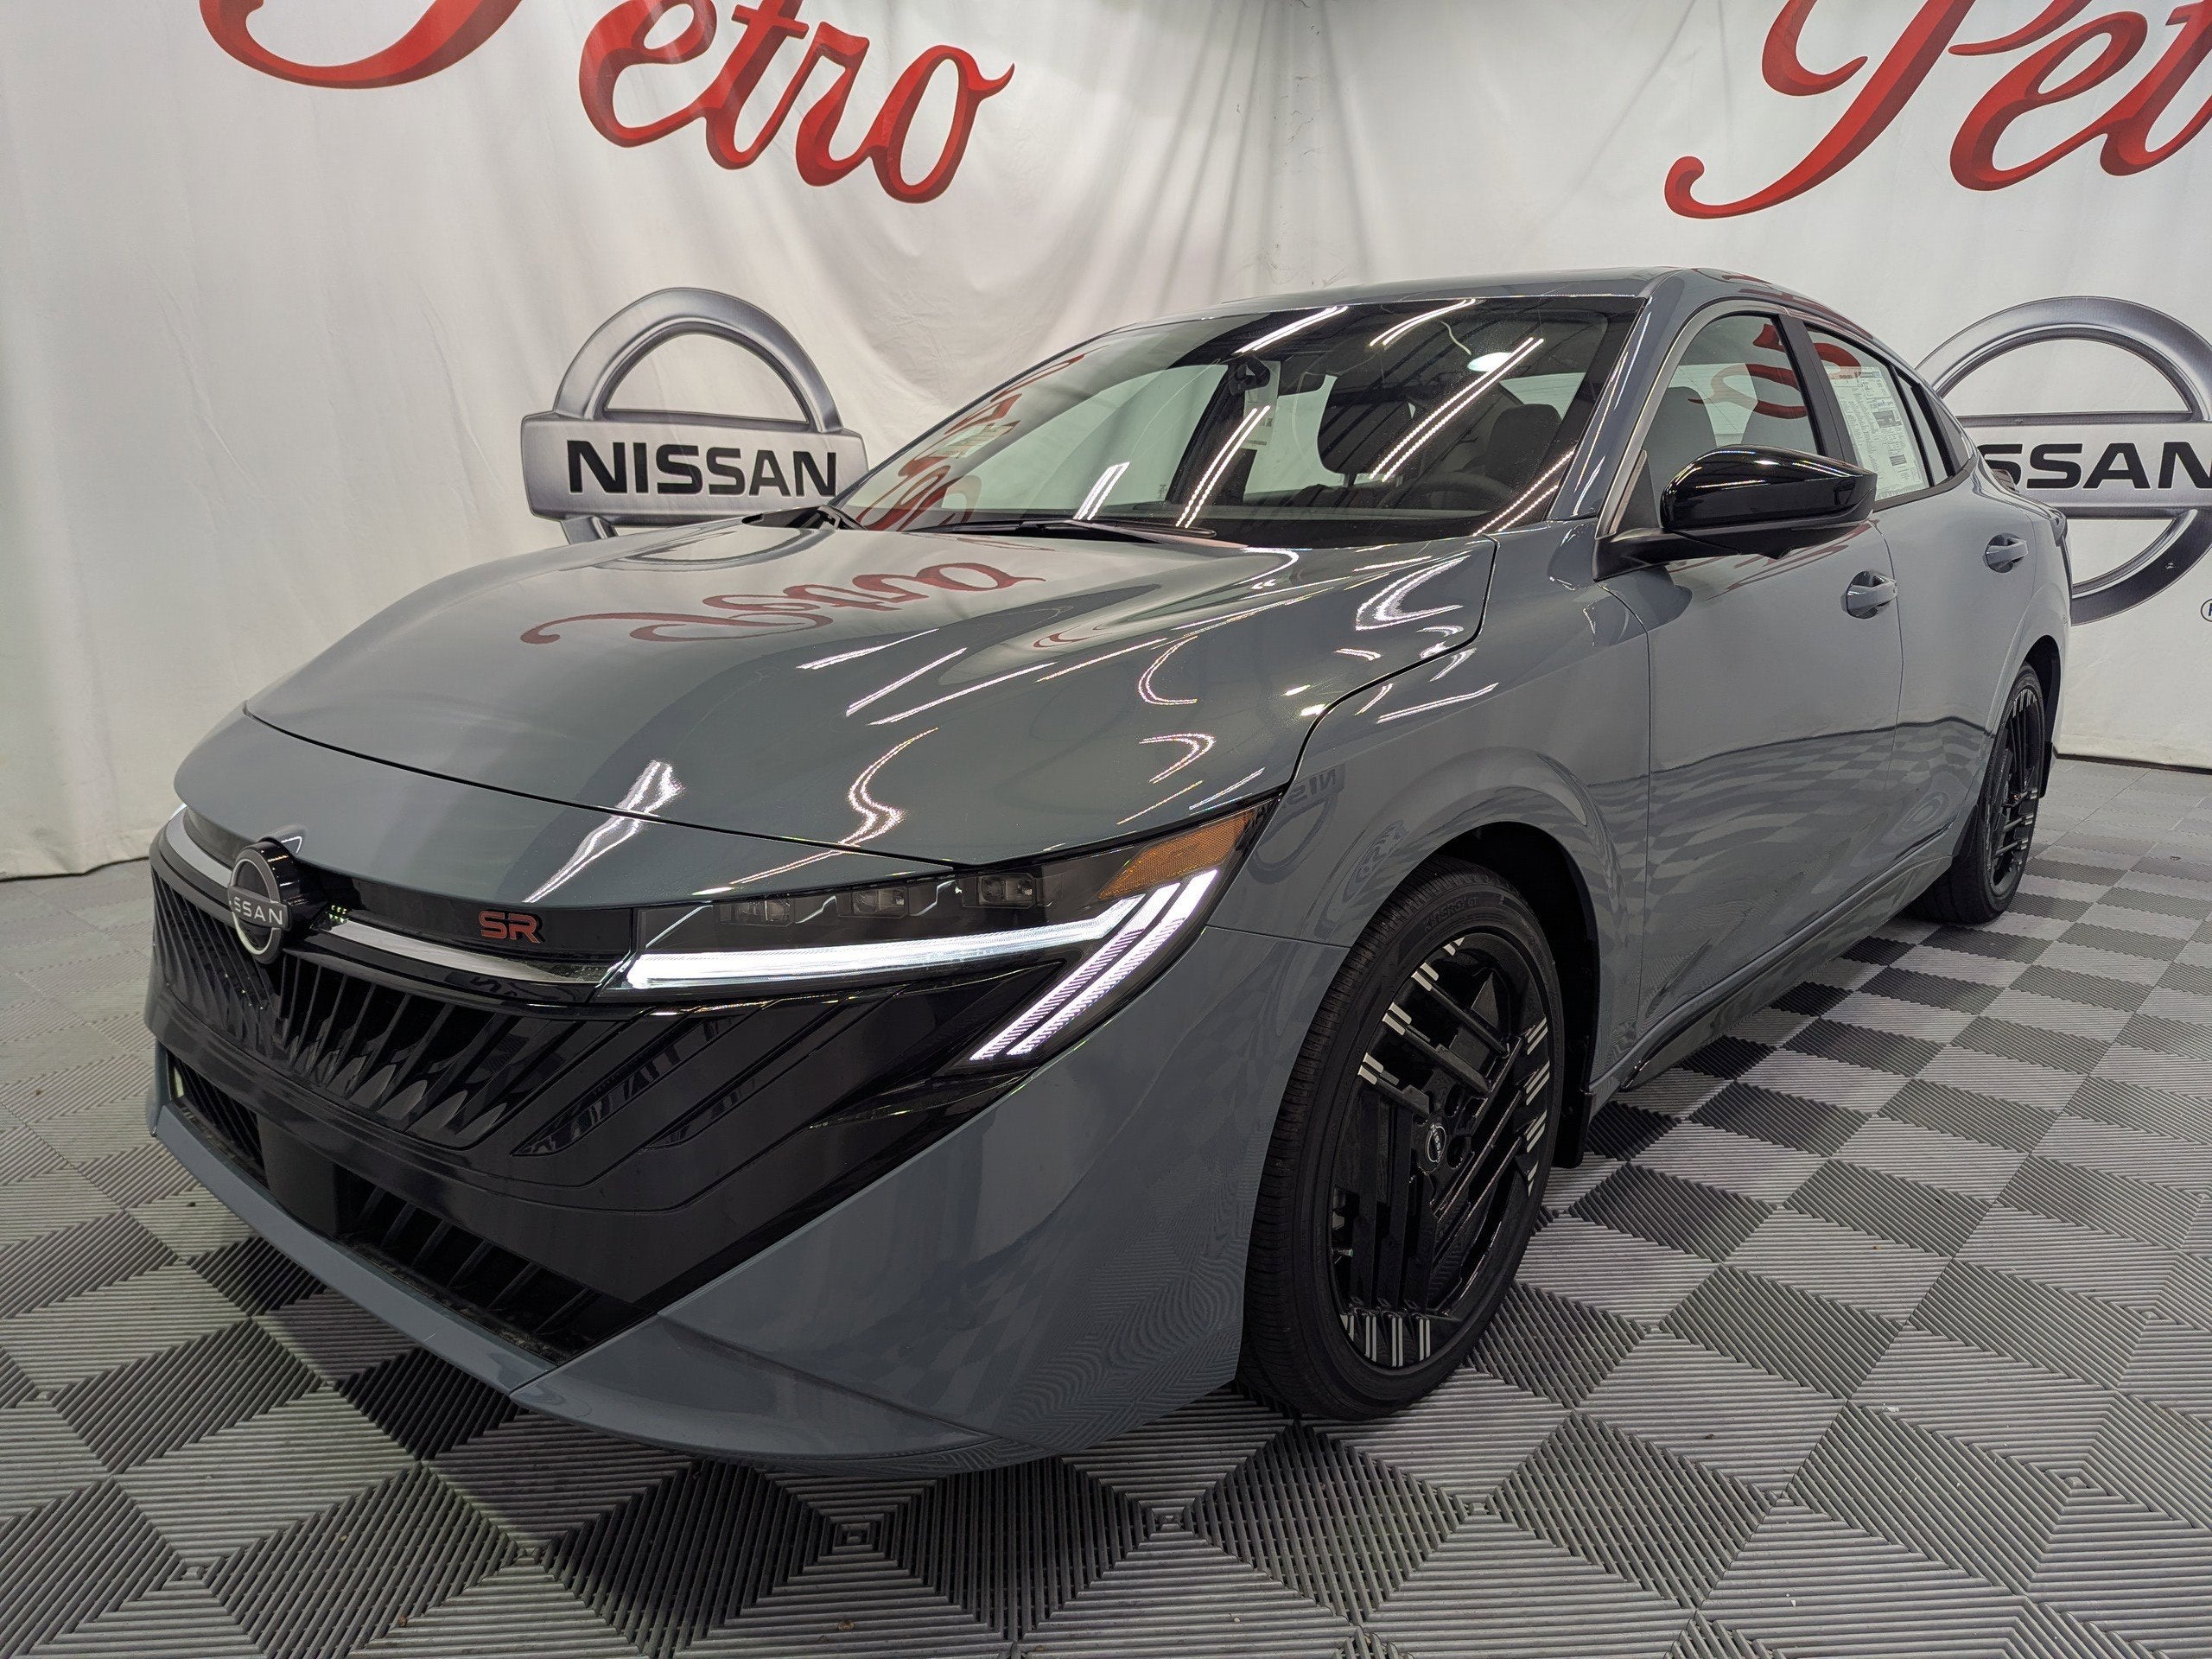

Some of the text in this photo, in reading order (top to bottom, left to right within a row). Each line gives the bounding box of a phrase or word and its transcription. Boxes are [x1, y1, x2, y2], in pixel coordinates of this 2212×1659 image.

[567, 440, 837, 497] NISSAN
[228, 896, 283, 925] SSAN
[478, 910, 541, 944] SR
